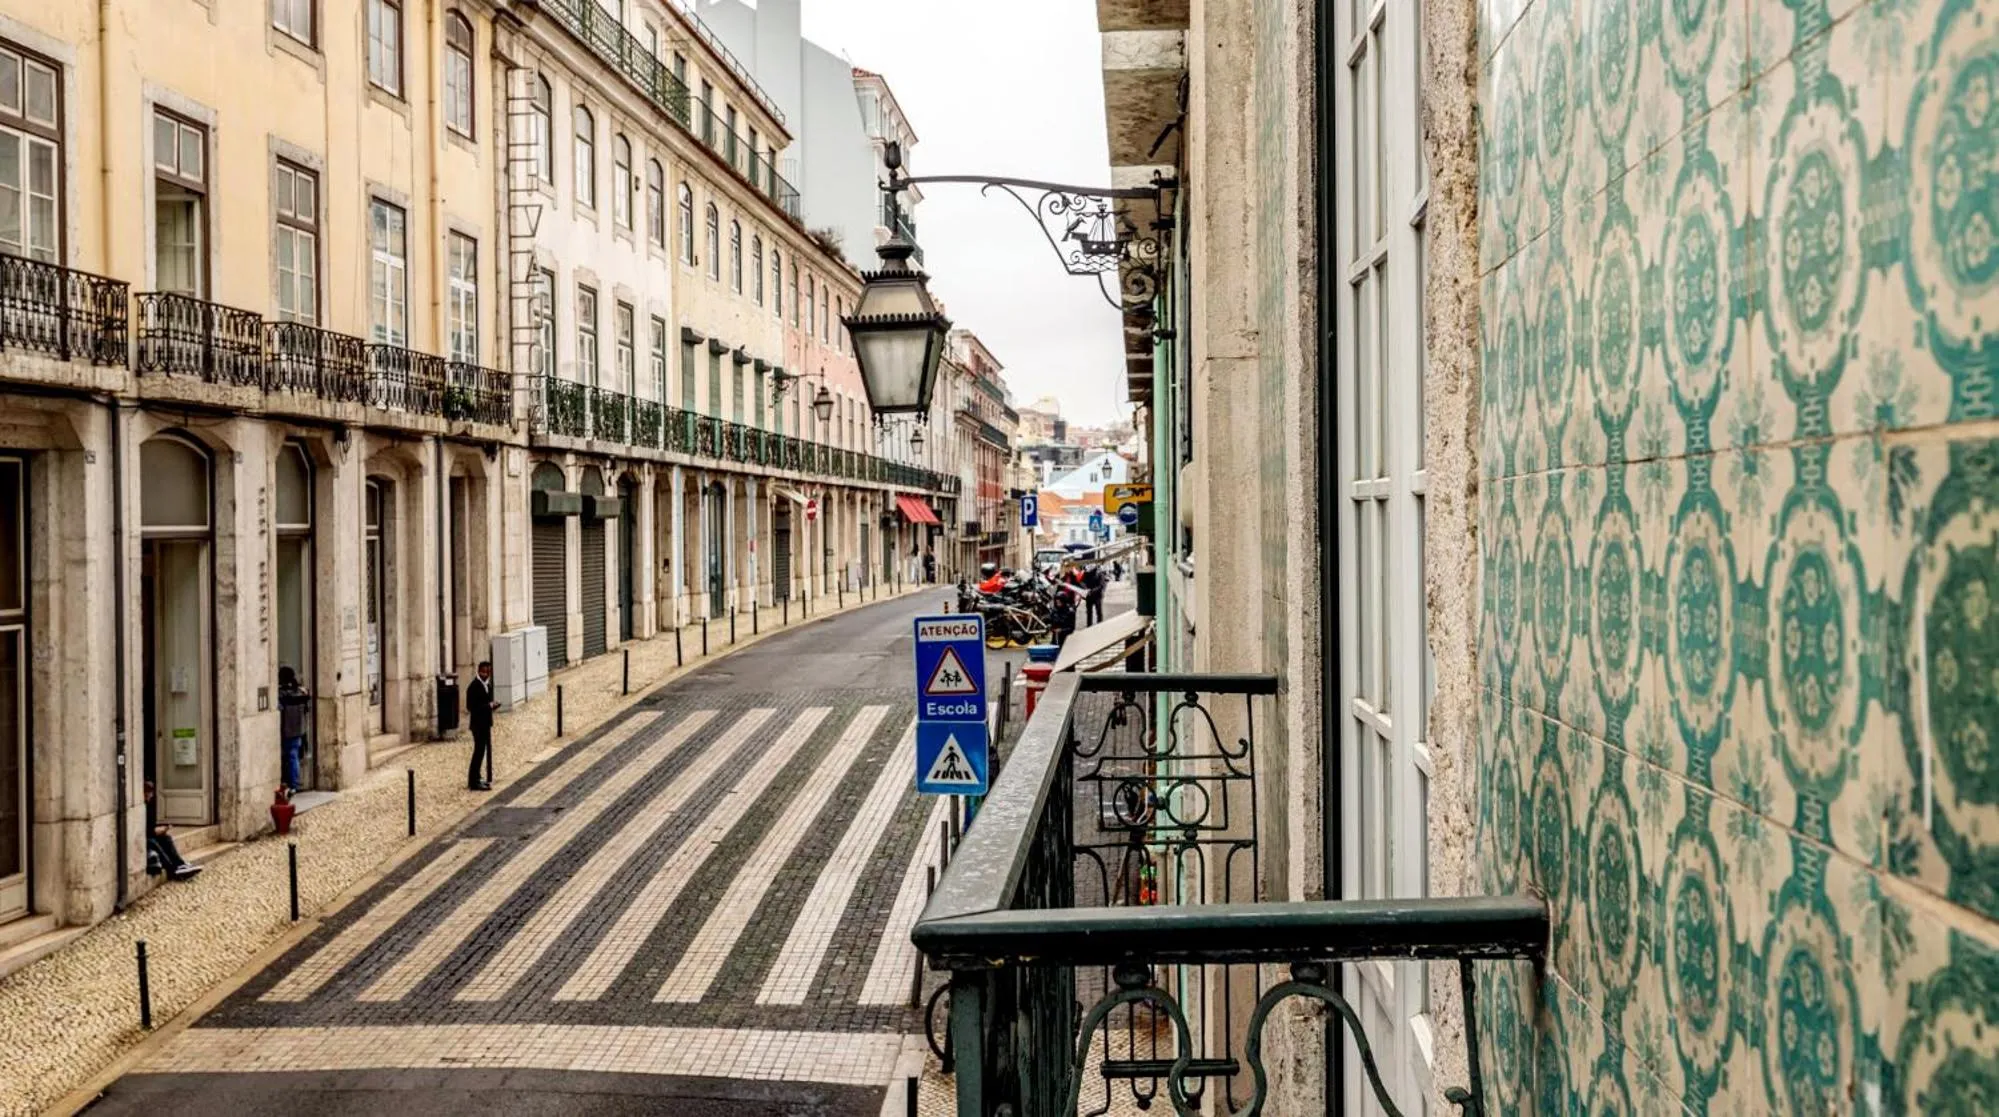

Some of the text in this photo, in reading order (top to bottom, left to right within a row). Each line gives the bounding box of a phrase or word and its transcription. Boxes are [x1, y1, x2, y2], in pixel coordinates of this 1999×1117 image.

[1023, 498, 1035, 524] P
[920, 624, 978, 636] ATENÇÃO
[926, 700, 977, 716] Escola
